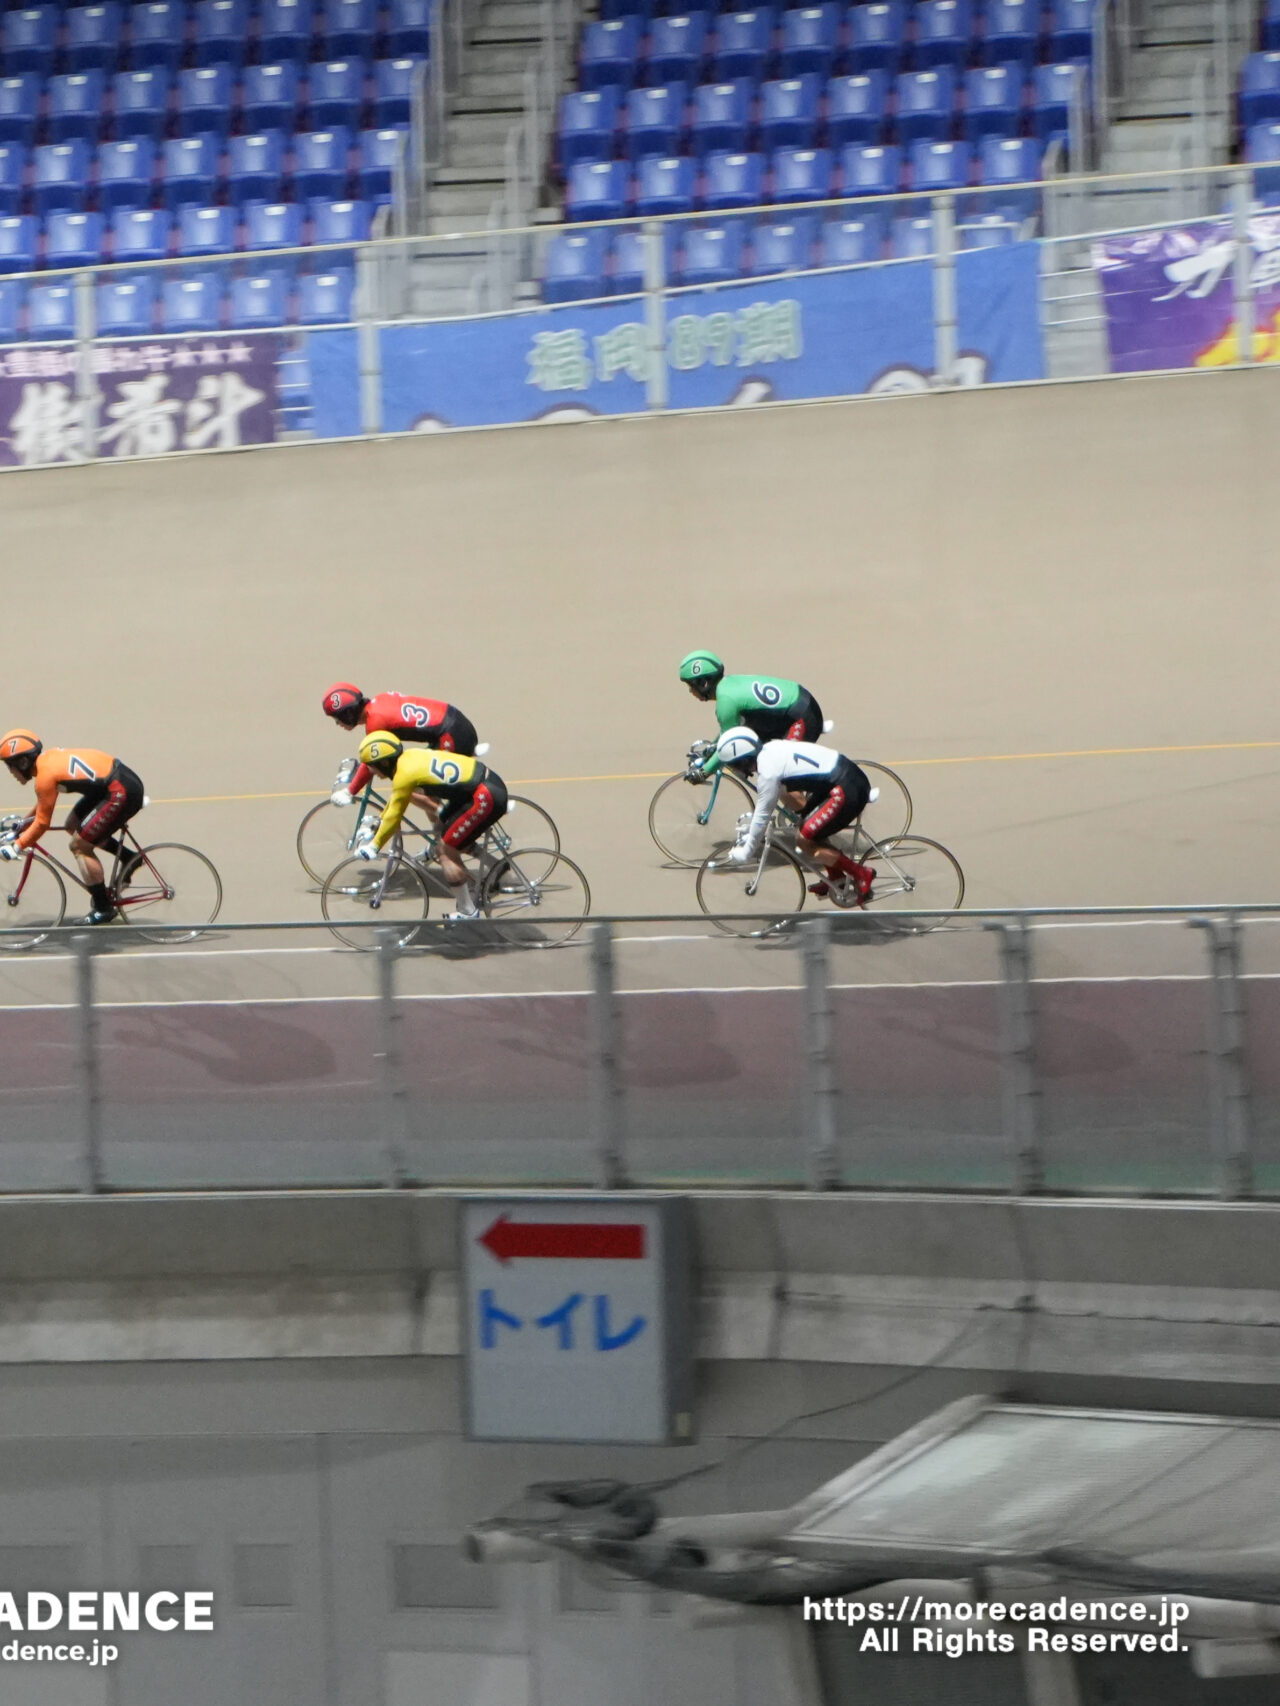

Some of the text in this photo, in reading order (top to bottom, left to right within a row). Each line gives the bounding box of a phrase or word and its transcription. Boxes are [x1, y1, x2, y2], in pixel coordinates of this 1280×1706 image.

[525, 299, 803, 391] 福岡89期
[691, 661, 702, 675] 6
[331, 693, 341, 709] 3
[752, 681, 783, 707] 6
[401, 702, 430, 728] 3
[8, 740, 18, 753] 7
[369, 743, 380, 759] 5
[731, 742, 738, 756] 1
[68, 755, 97, 782] 7
[429, 756, 462, 785] 5
[793, 753, 820, 769] 1
[478, 1288, 648, 1351] トイレ
